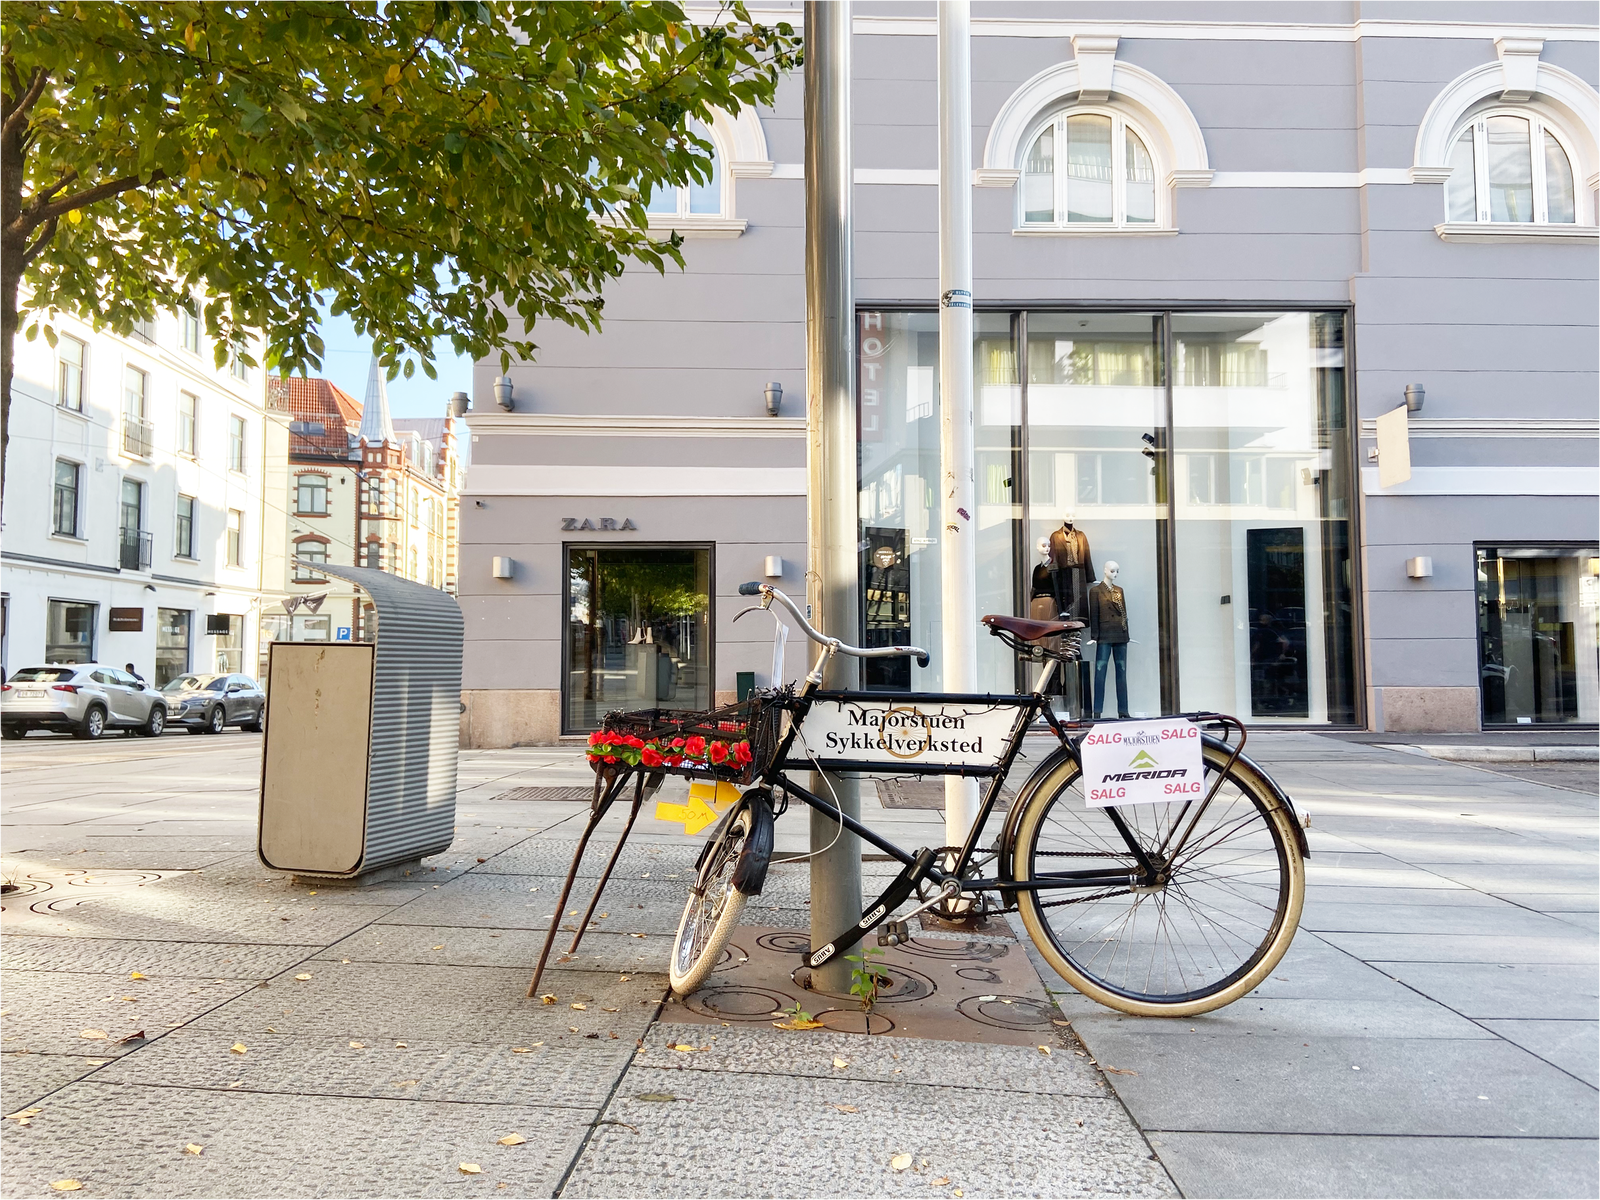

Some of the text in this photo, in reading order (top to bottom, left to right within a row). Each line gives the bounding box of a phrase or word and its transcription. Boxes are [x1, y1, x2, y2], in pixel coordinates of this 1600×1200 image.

[561, 517, 637, 531] ZARA
[339, 628, 348, 639] P
[847, 709, 966, 732] Majorstuen
[1087, 733, 1122, 745] SALG
[1161, 727, 1198, 740] SALG
[825, 731, 984, 754] Sykkelverksted
[1101, 769, 1188, 783] MERIDA
[1090, 787, 1126, 800] SALG
[1164, 782, 1201, 794] SALG
[679, 808, 697, 820] 50
[813, 946, 831, 964] ABUS
